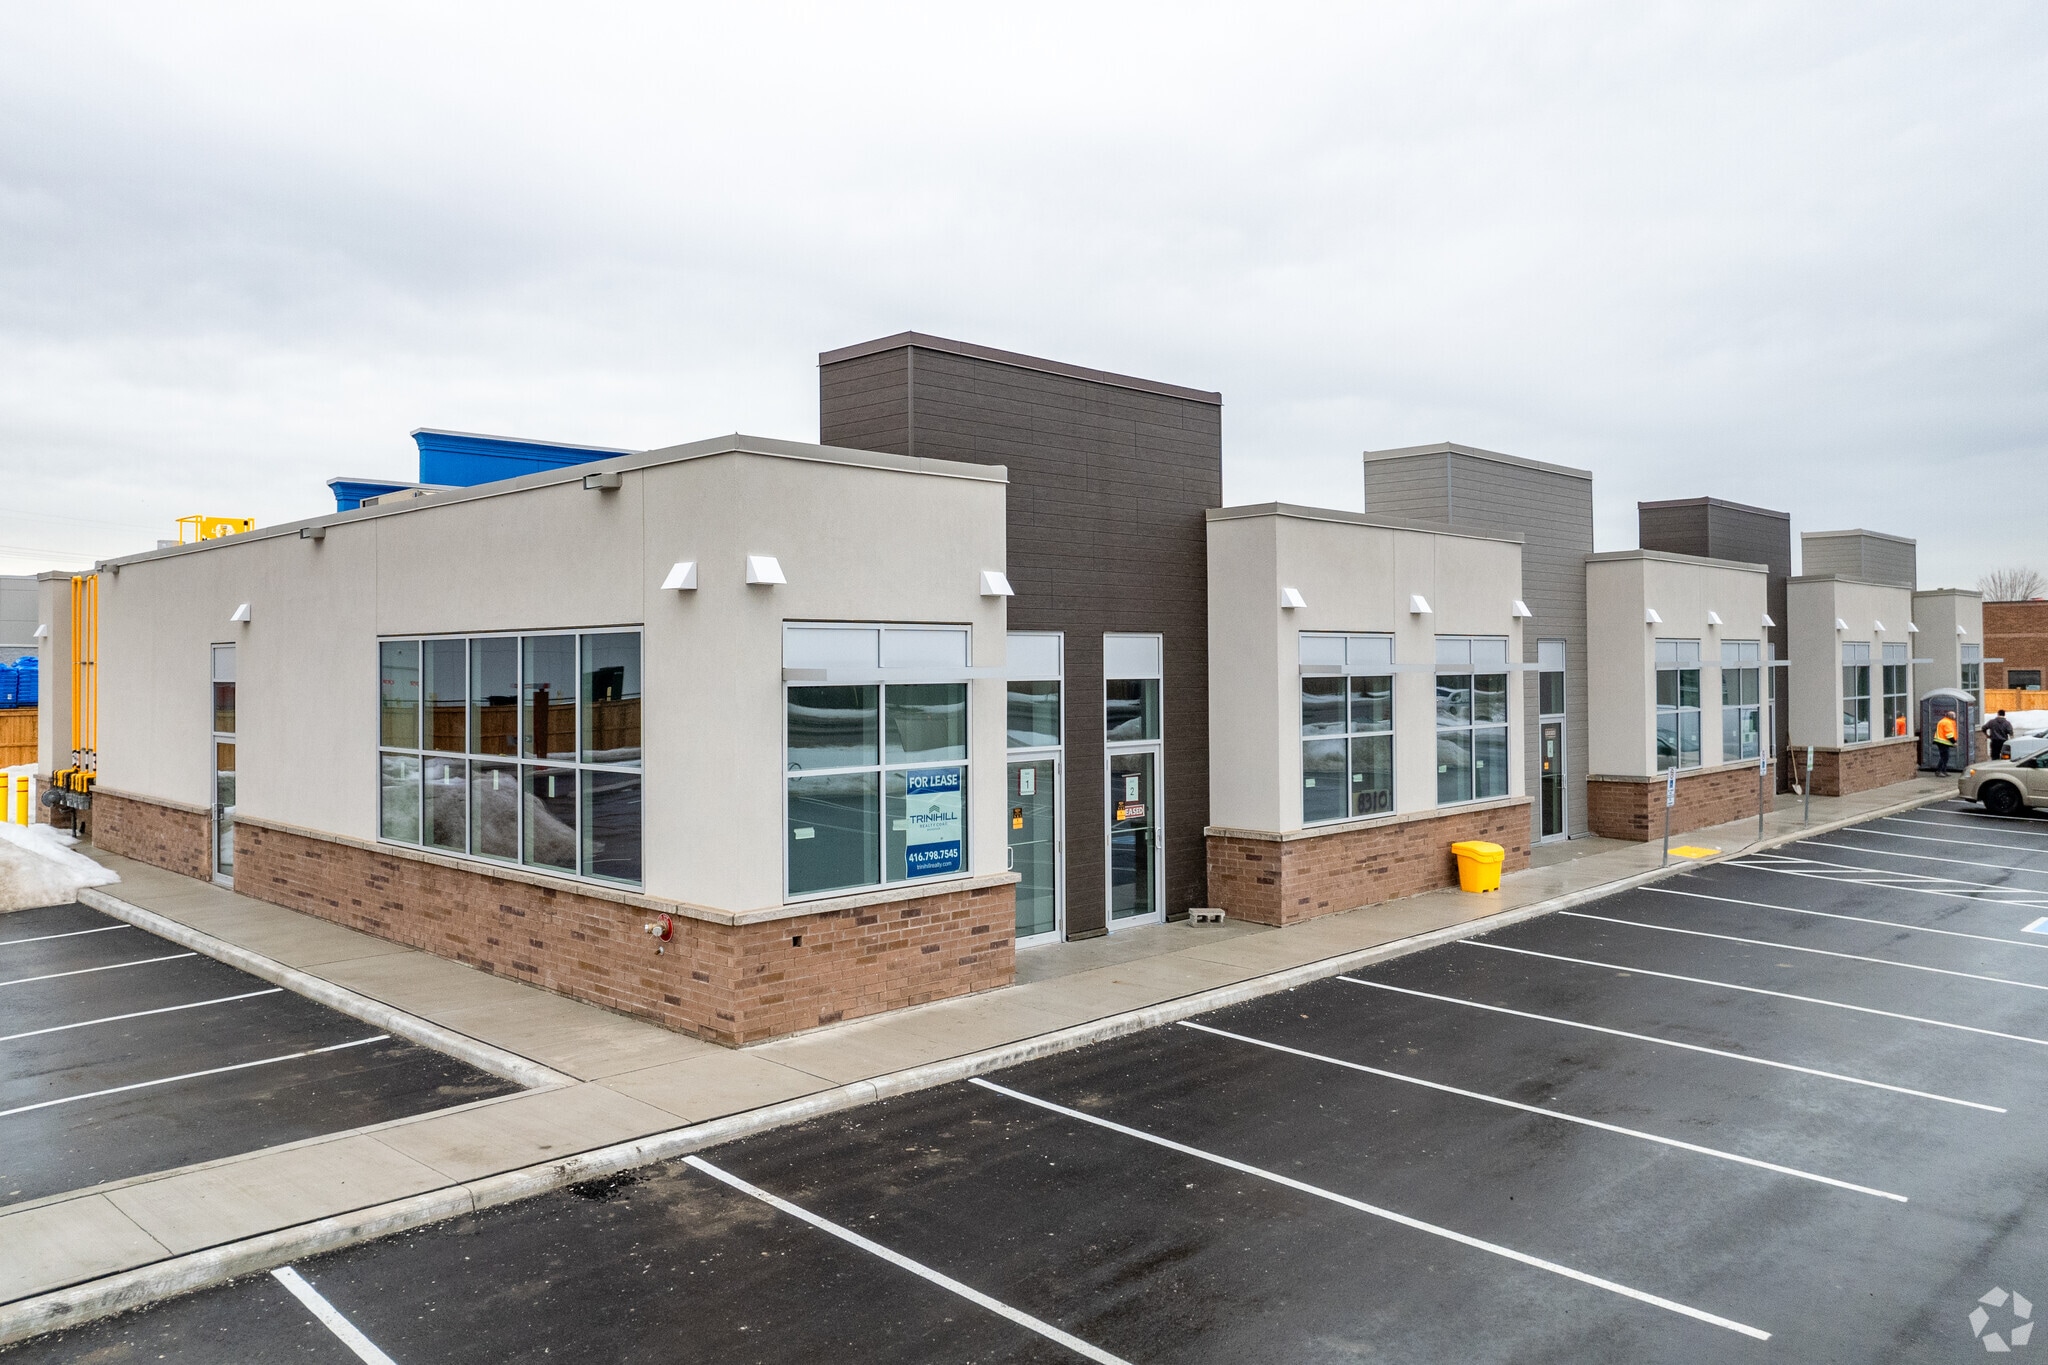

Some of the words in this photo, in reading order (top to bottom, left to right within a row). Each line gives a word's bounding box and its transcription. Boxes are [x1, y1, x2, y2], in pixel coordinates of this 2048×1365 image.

[909, 776, 928, 789] FOR
[930, 774, 958, 787] LEASE
[1130, 787, 1134, 796] 2
[1126, 806, 1143, 815] EASED
[908, 848, 958, 862] 416.798.7545
